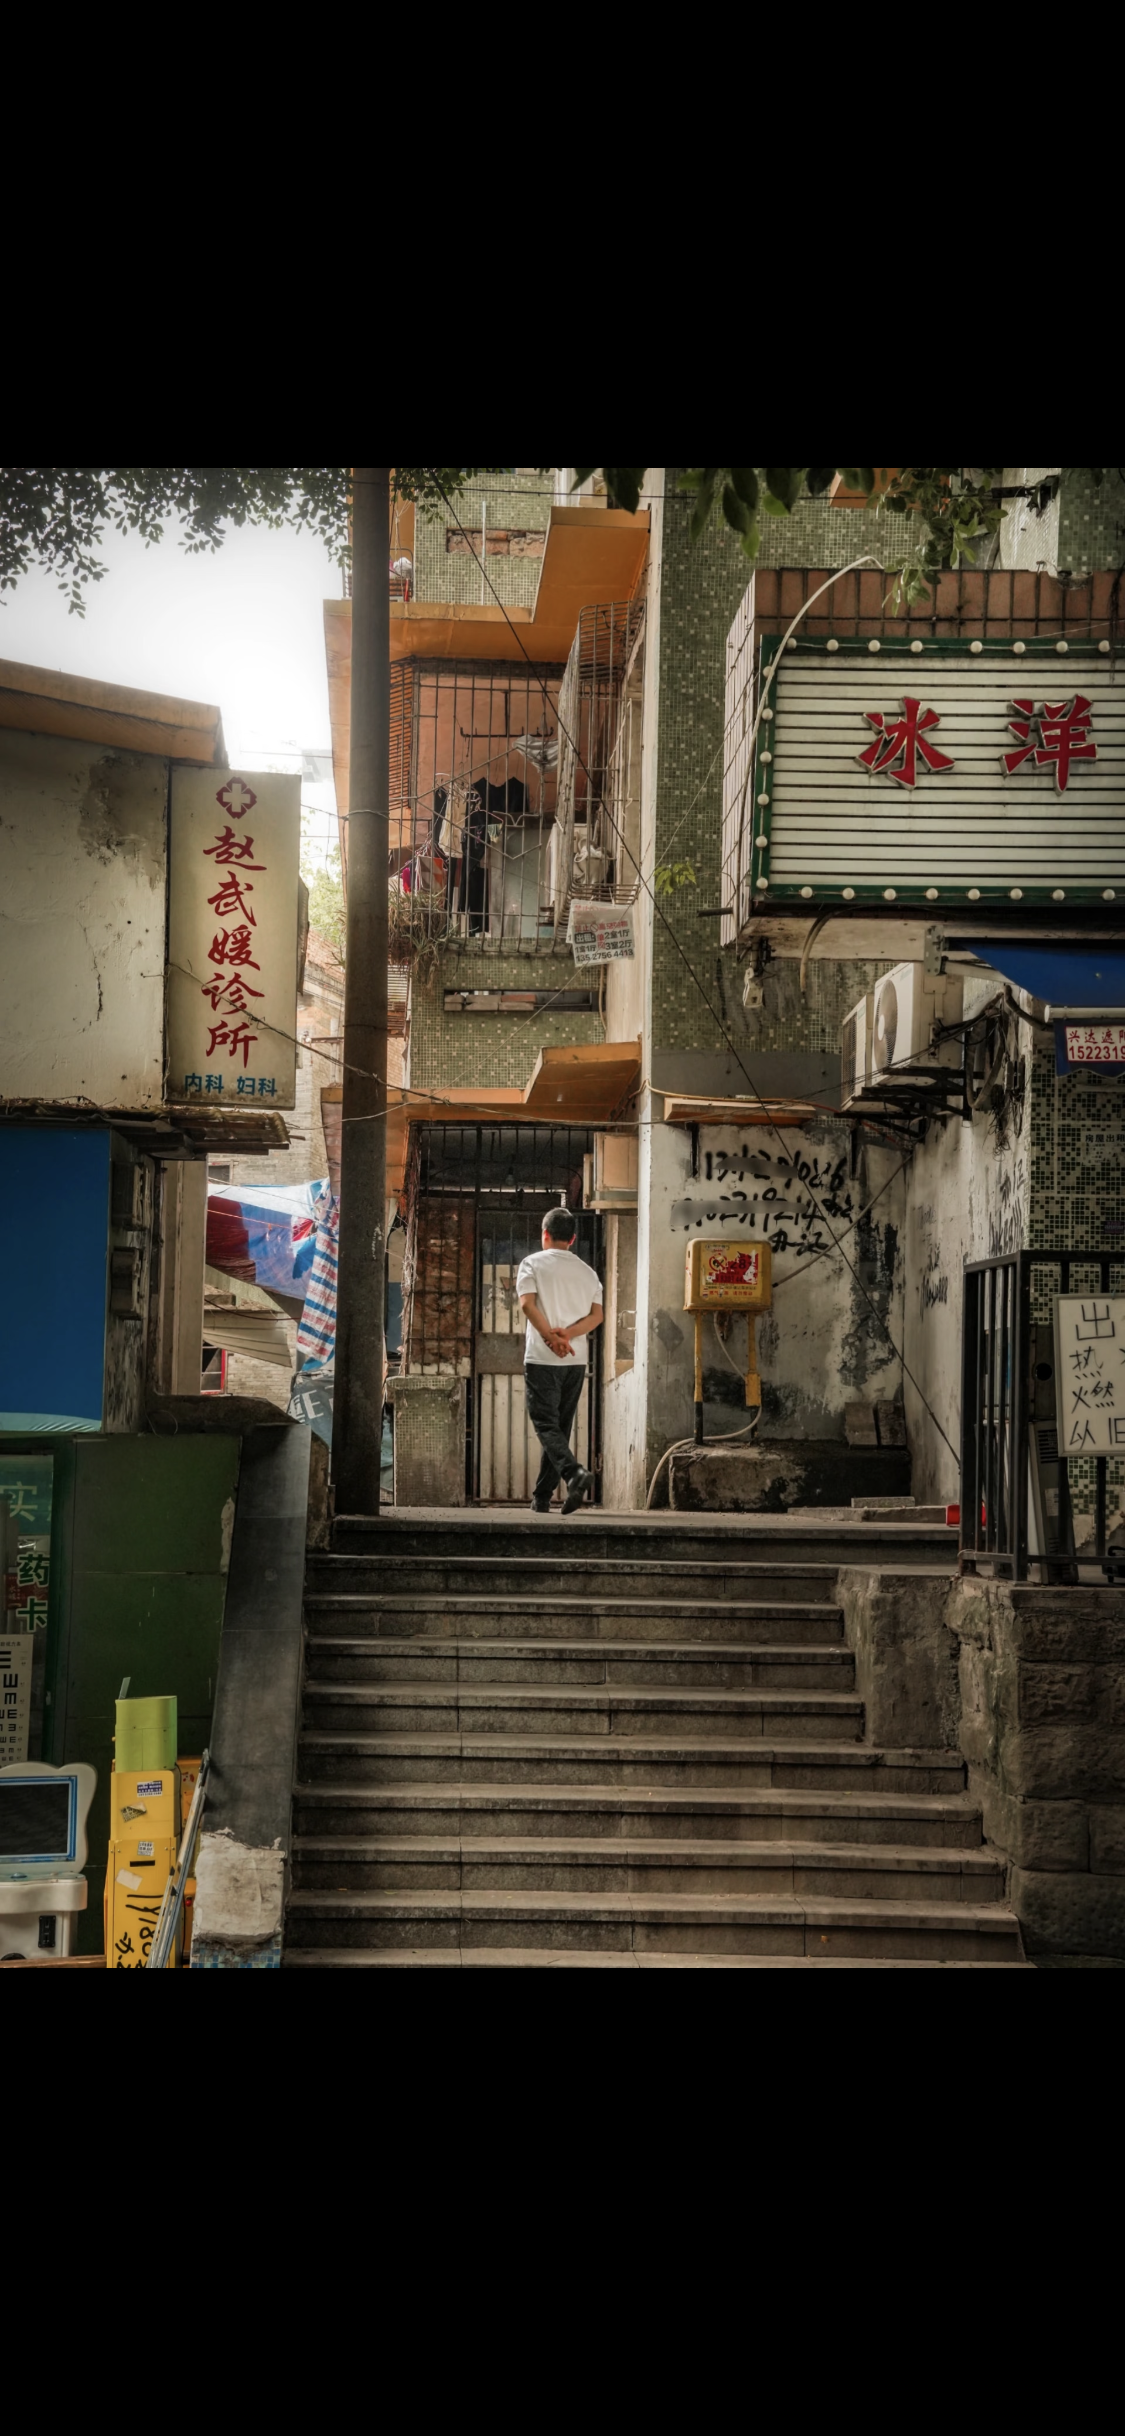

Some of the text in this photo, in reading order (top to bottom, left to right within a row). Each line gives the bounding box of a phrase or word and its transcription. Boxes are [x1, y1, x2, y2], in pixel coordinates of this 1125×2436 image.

[203, 826, 267, 1069] 赵武媛诊所
[184, 1072, 277, 1097] 内科 妇科
